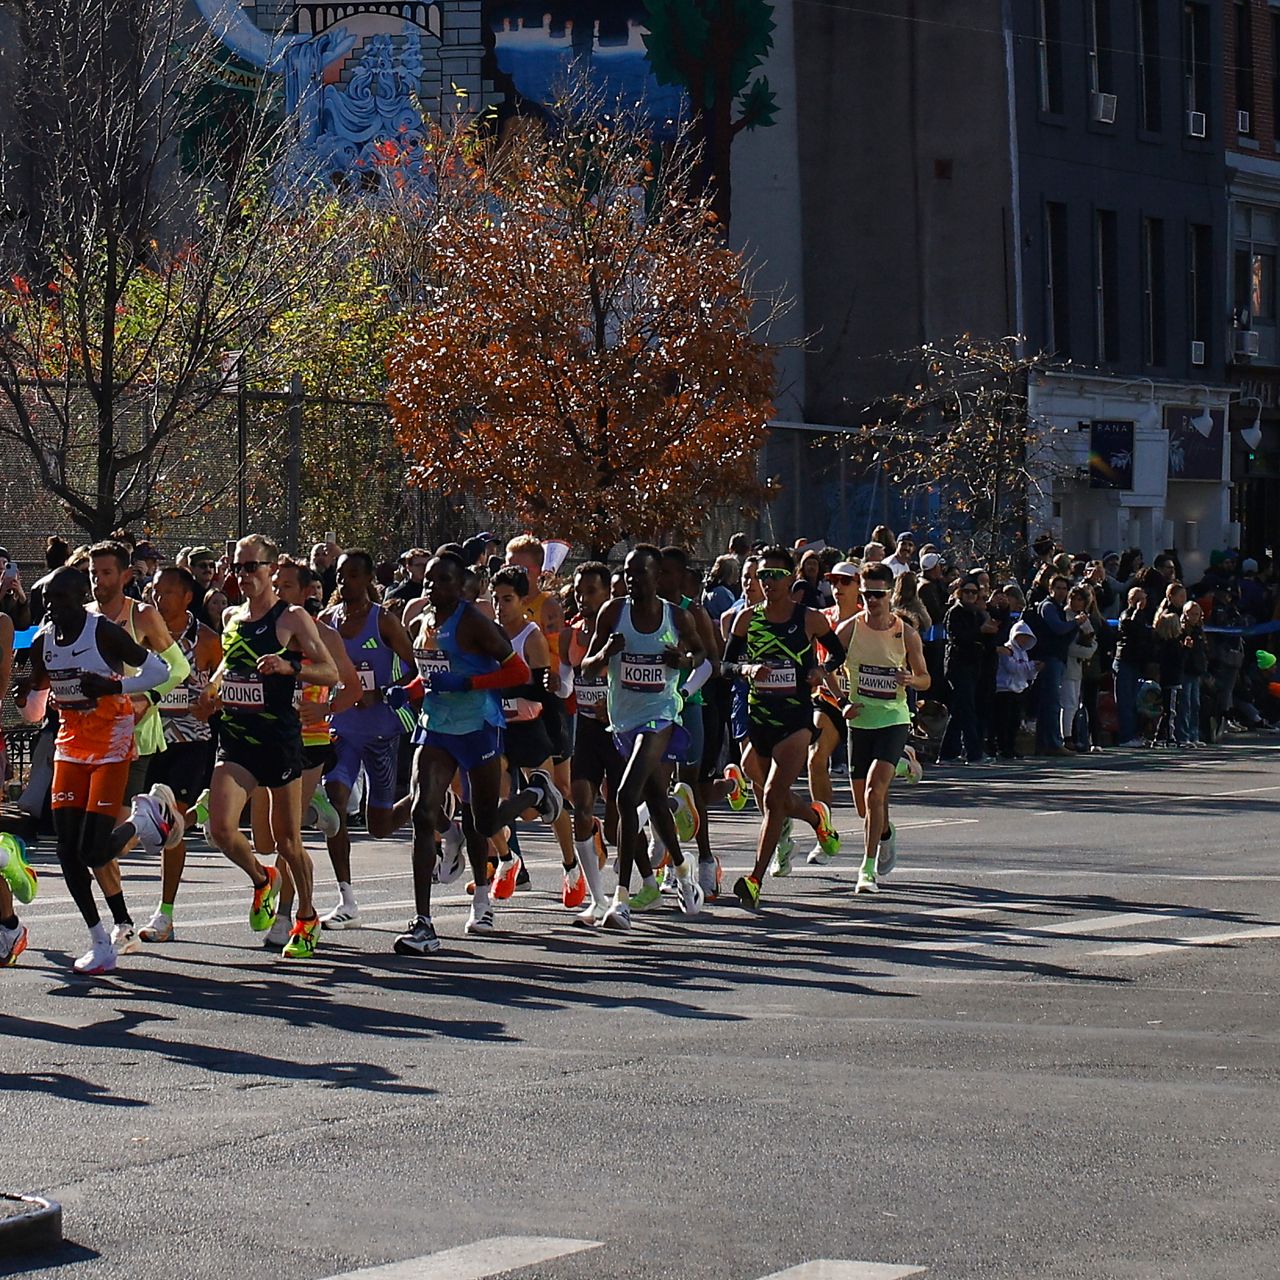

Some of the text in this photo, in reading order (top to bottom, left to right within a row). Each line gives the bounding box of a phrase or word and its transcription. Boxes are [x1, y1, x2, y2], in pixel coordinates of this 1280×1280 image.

[625, 667, 663, 682] KORIR
[766, 672, 795, 683] NTANEZ
[859, 676, 897, 689] HAWKINS
[160, 693, 188, 704] OCHIR
[222, 685, 262, 703] YOUNG
